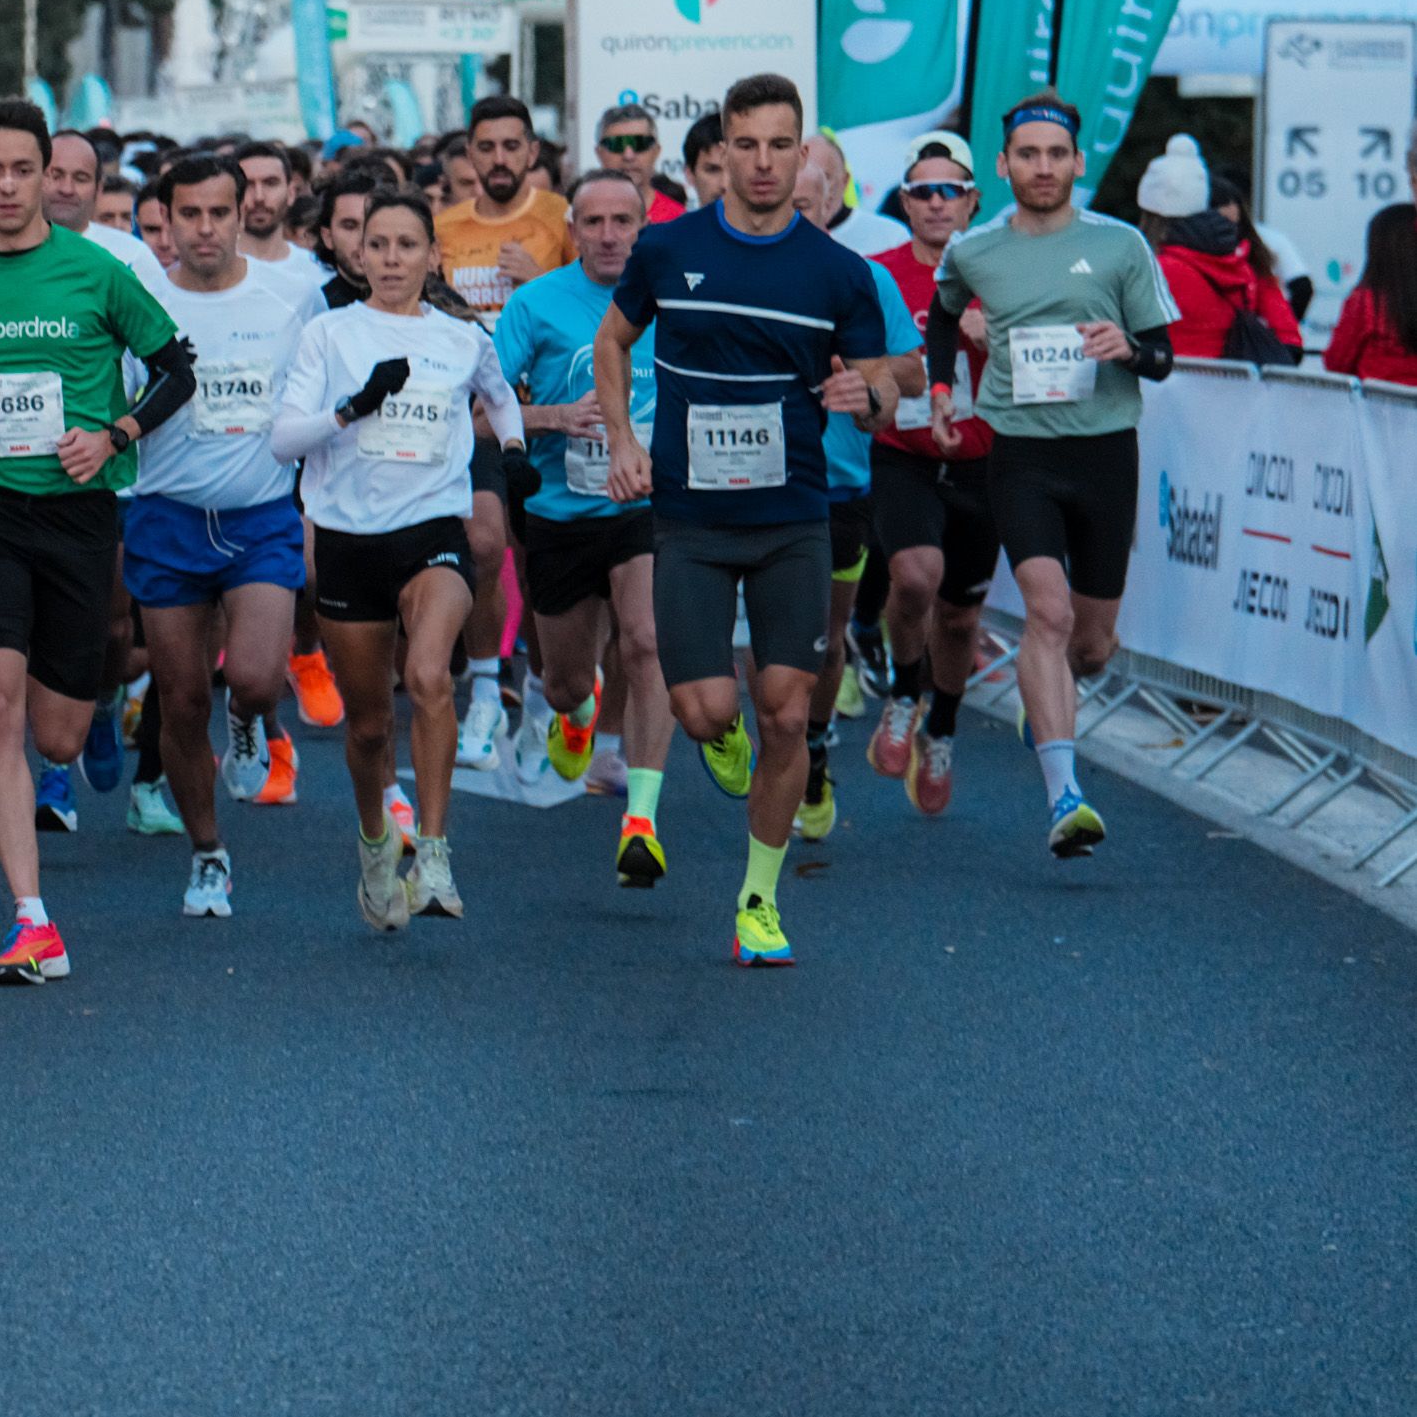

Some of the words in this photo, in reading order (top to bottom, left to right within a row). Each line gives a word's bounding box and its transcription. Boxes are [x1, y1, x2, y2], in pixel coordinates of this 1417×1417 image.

[642, 93, 722, 121] Saba
[1276, 169, 1327, 200] 05
[1355, 170, 1397, 201] 10
[200, 379, 263, 399] 13746
[704, 428, 770, 447] 11146
